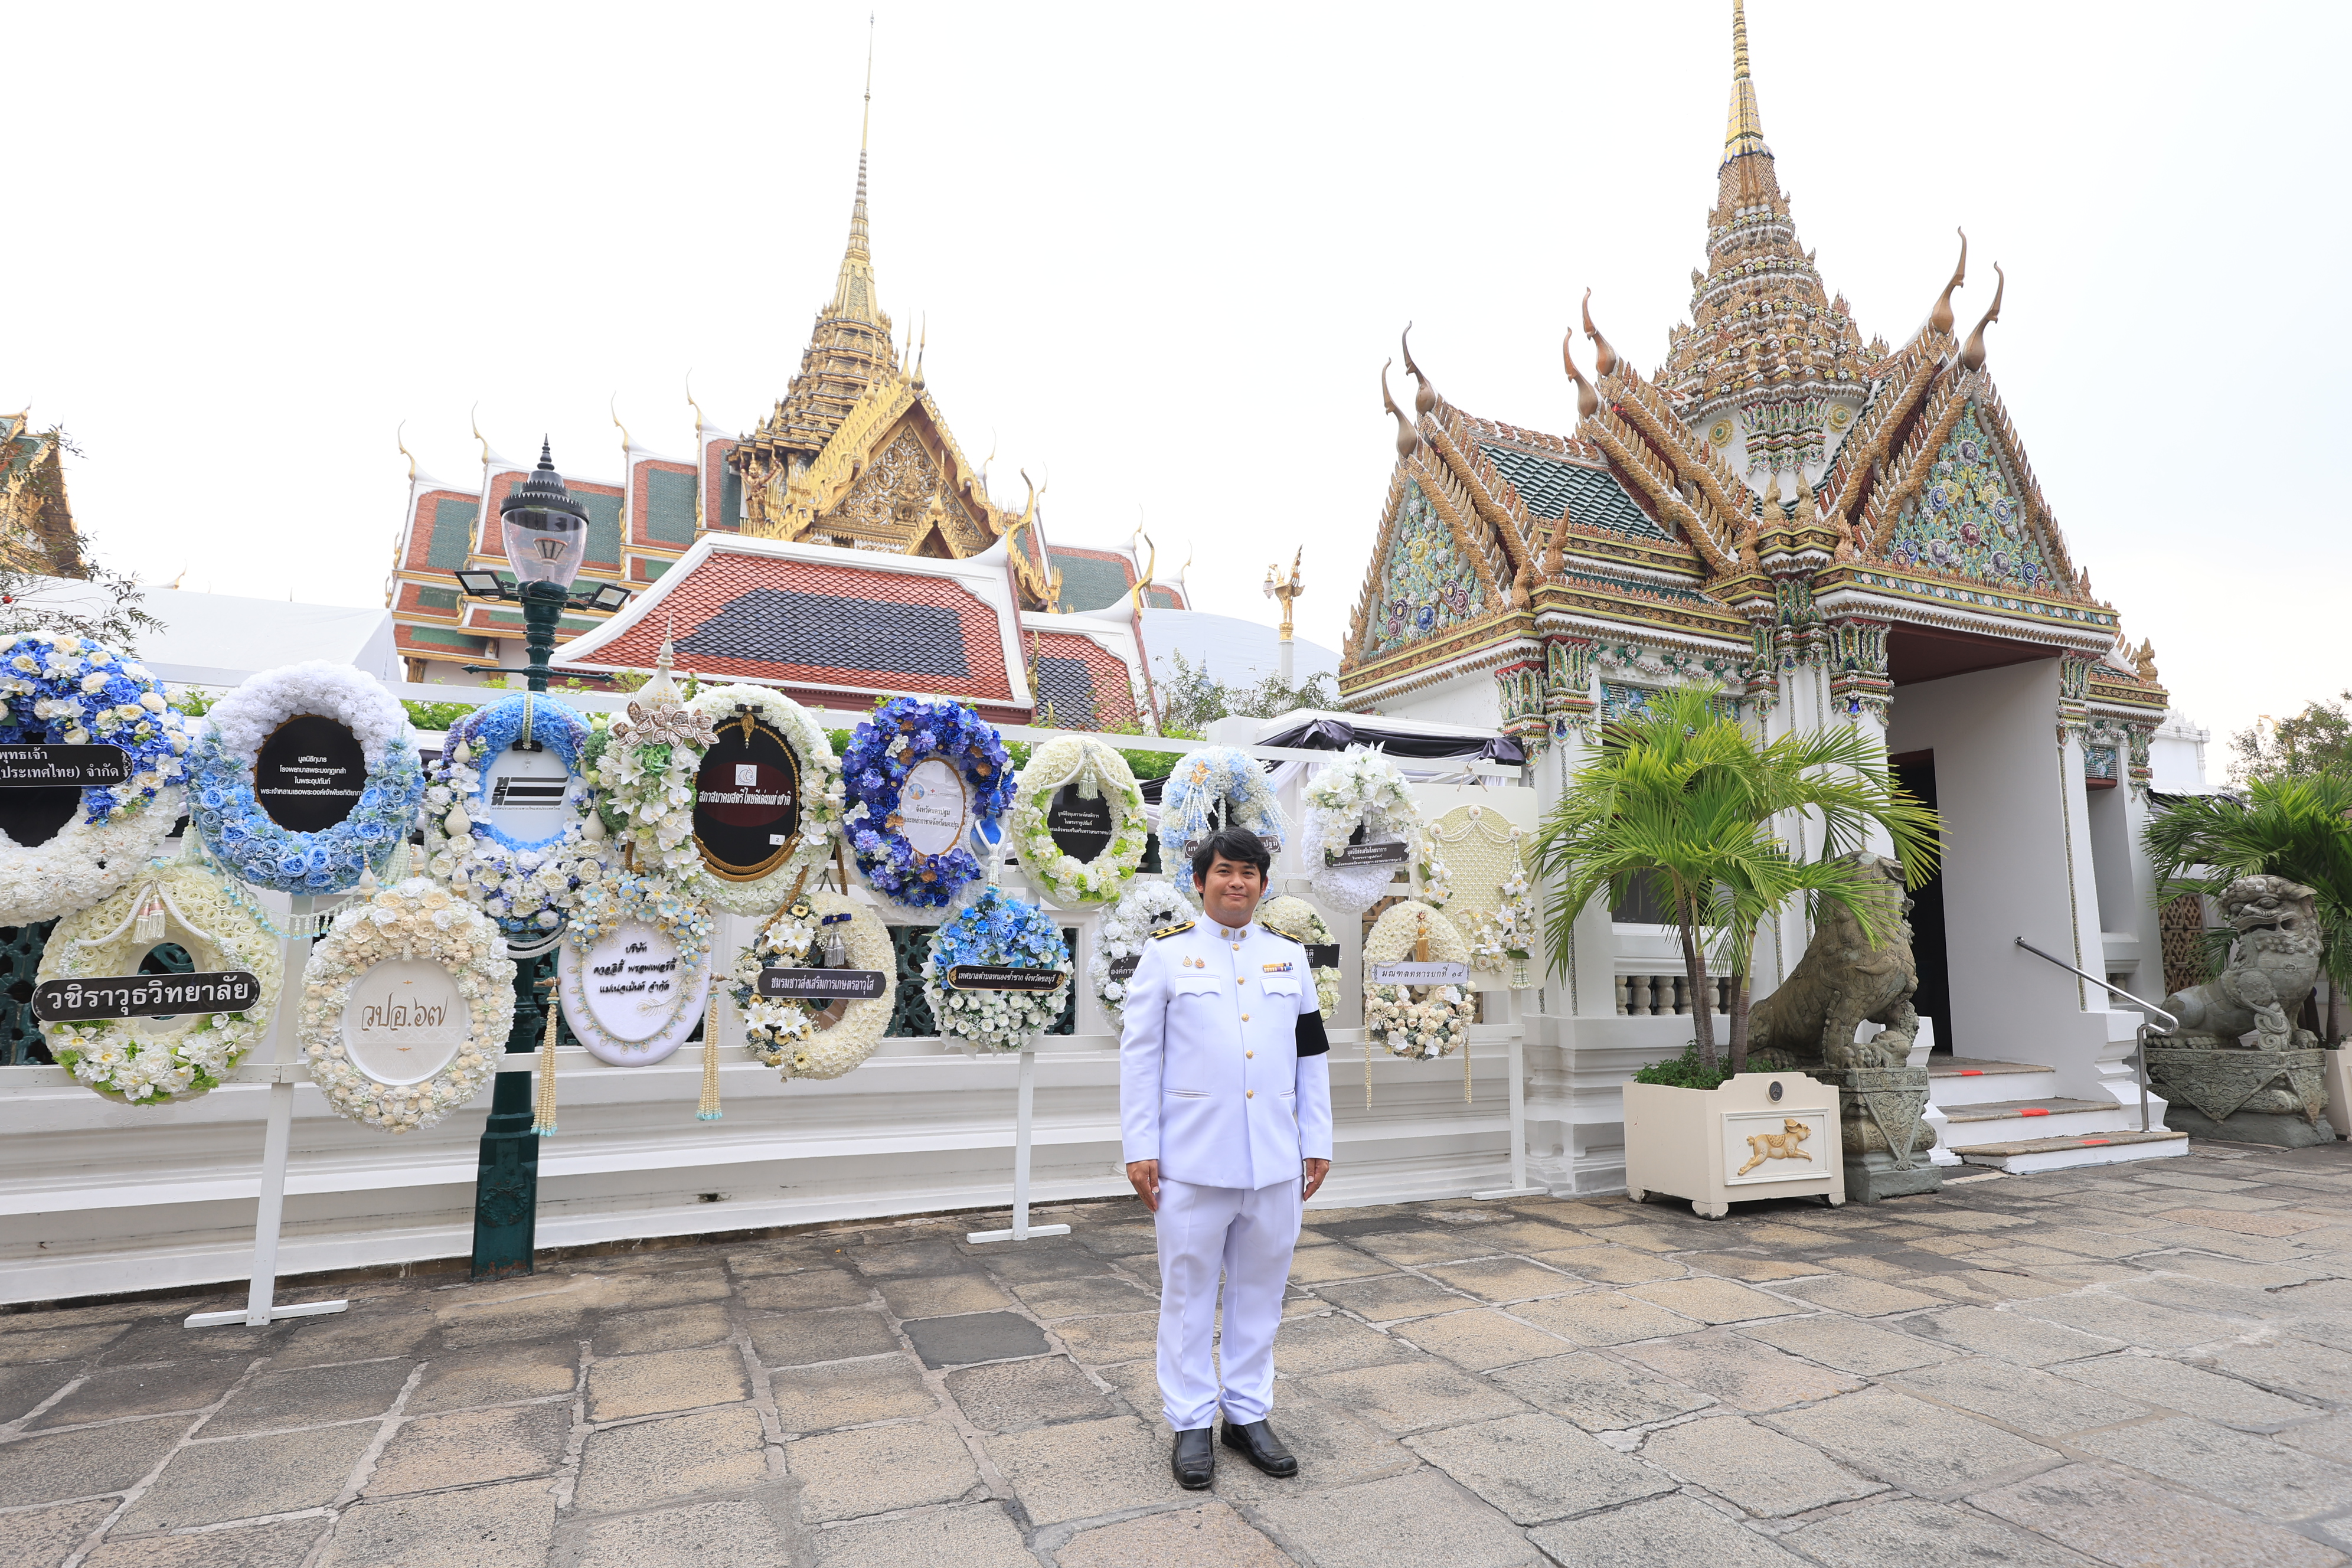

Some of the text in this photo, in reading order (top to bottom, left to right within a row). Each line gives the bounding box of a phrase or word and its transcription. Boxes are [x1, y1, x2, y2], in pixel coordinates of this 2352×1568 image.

[298, 755, 327, 764] มูลนิธิกุมาร
[0, 763, 119, 779] ประเทศไทย) จำกัด
[295, 776, 331, 786] ในพระอุปถัมภ์
[698, 787, 792, 806] สภาสมาคมสตรีไทยดีเด่นแห่งชาติ
[916, 804, 950, 817] จังหวัดนครปฐม
[626, 942, 647, 953] บริษัท
[593, 959, 626, 975] ควอลิตี้
[1381, 963, 1466, 978] มณฑลทหารบกที่ ๑๔
[648, 979, 670, 992] จำกัด
[771, 975, 874, 995] ชมรมชาวส่งเสริมการเกษตรอาวุโส
[1024, 973, 1056, 985] จังหวัดชลบุรี
[47, 975, 249, 1015] วชิราวุธวิทยาลัย
[361, 991, 448, 1031] วปอ.๖๗
